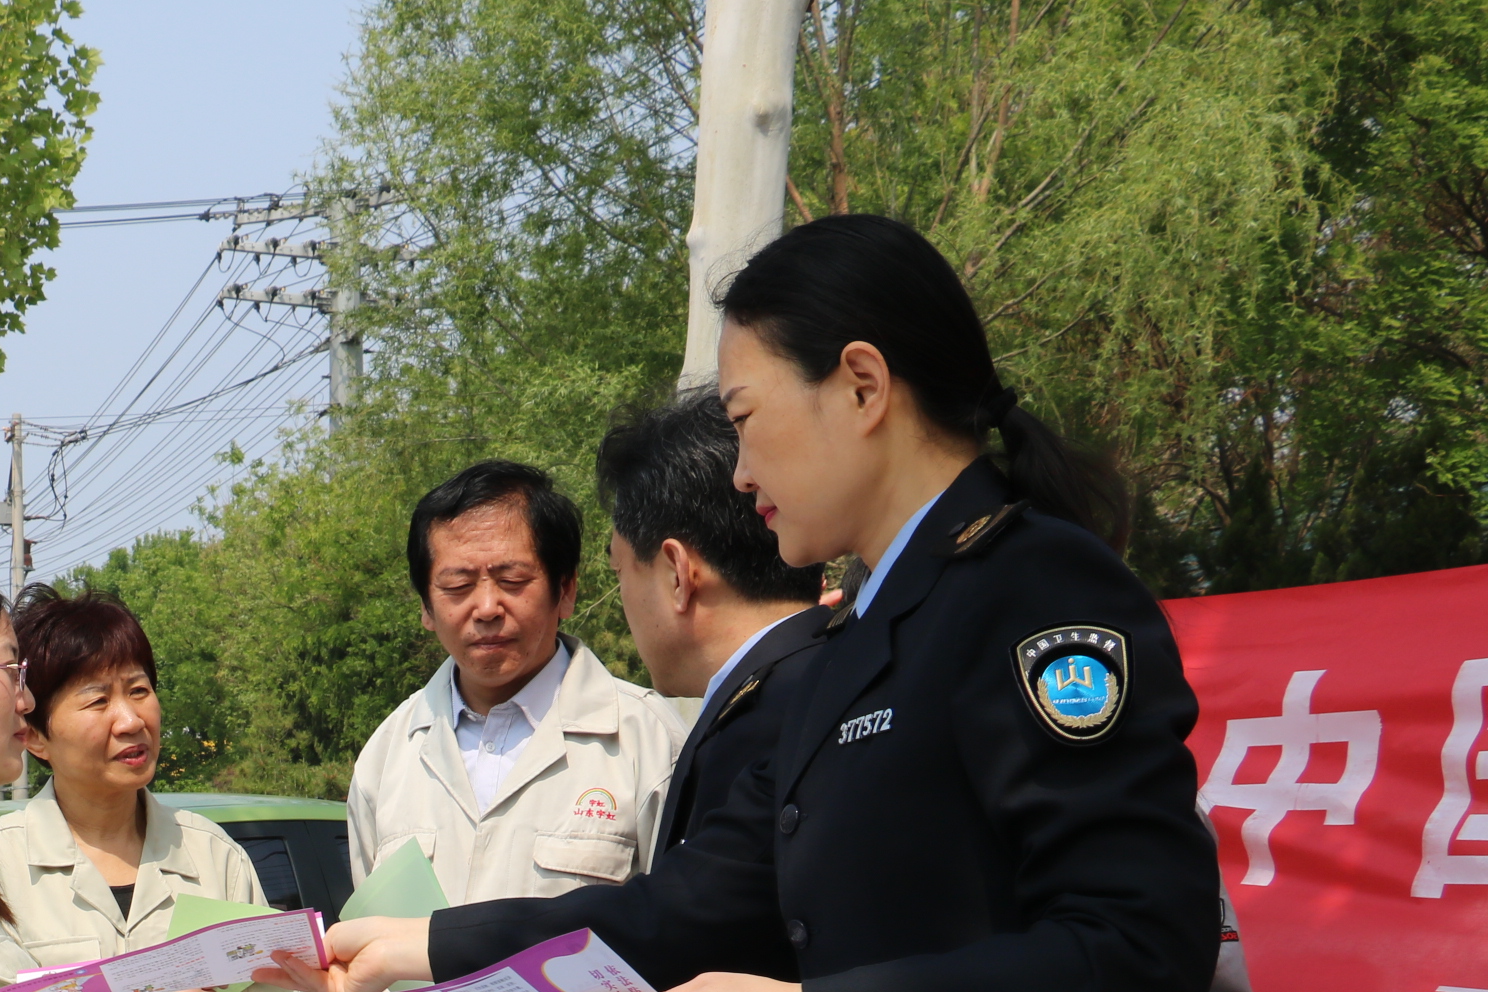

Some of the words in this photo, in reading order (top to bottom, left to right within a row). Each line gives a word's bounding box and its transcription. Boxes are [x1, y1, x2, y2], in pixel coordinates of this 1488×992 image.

[1026, 631, 1117, 658] 中国卫生监督
[838, 708, 893, 744] 377572
